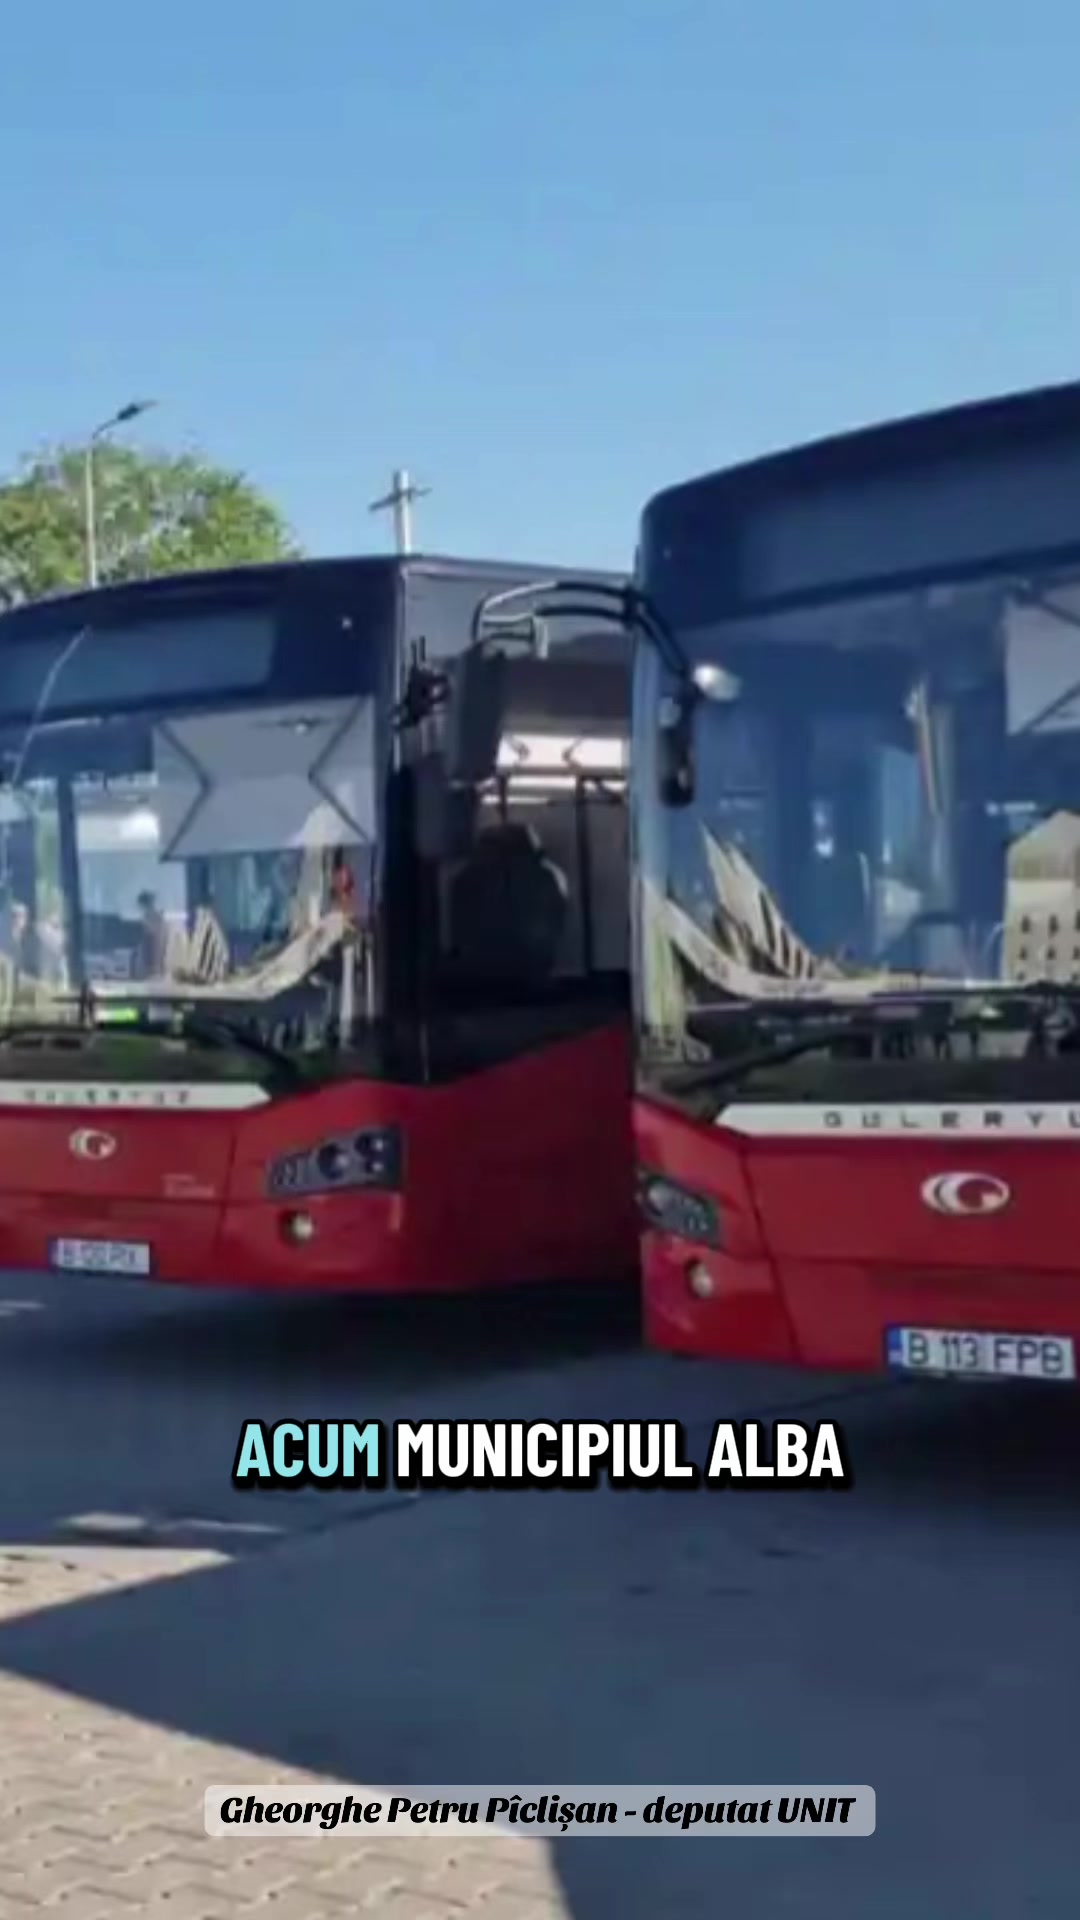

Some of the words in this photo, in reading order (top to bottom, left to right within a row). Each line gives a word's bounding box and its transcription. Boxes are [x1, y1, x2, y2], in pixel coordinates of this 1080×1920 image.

[908, 1332, 929, 1366] B
[941, 1335, 978, 1369] 113
[993, 1337, 1063, 1375] FPB
